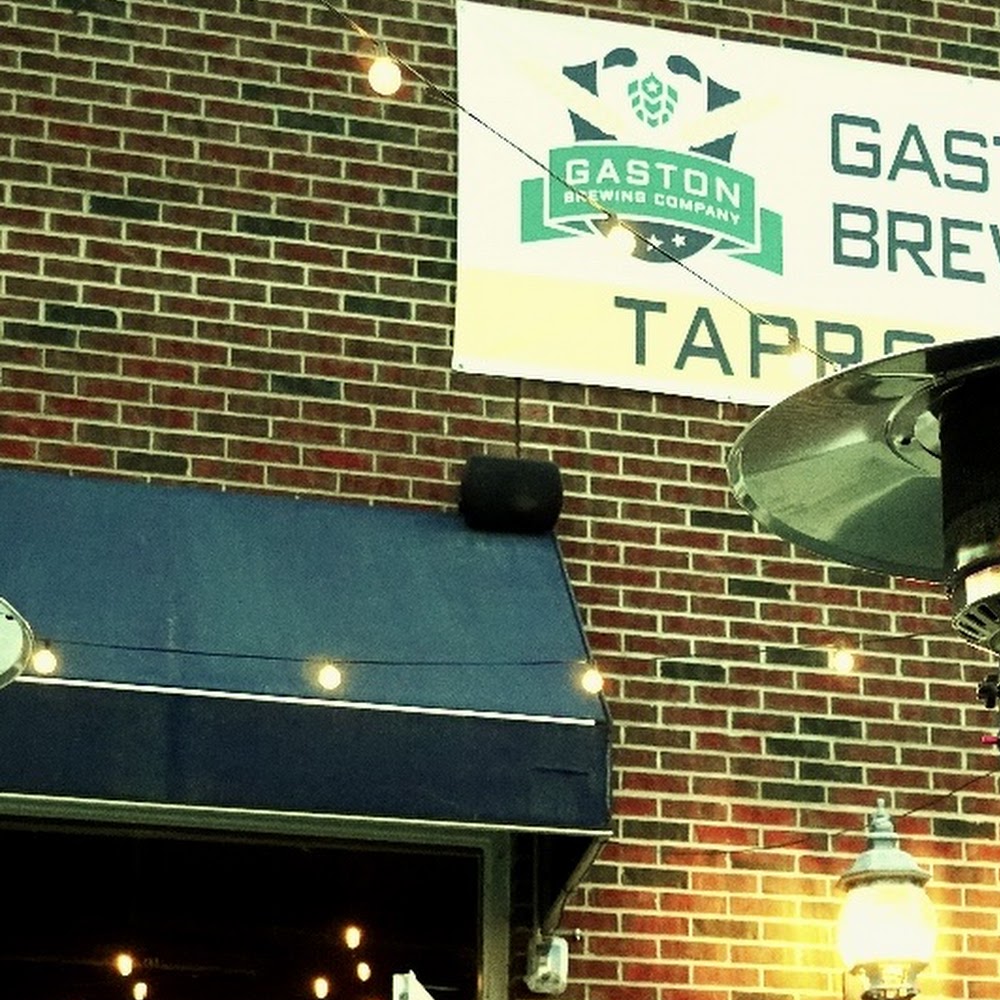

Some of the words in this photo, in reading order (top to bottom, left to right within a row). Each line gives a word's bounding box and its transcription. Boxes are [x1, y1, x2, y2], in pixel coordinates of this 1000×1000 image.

[564, 158, 741, 209] GASTON
[563, 189, 647, 204] BREWING
[653, 193, 741, 226] COMPANY
